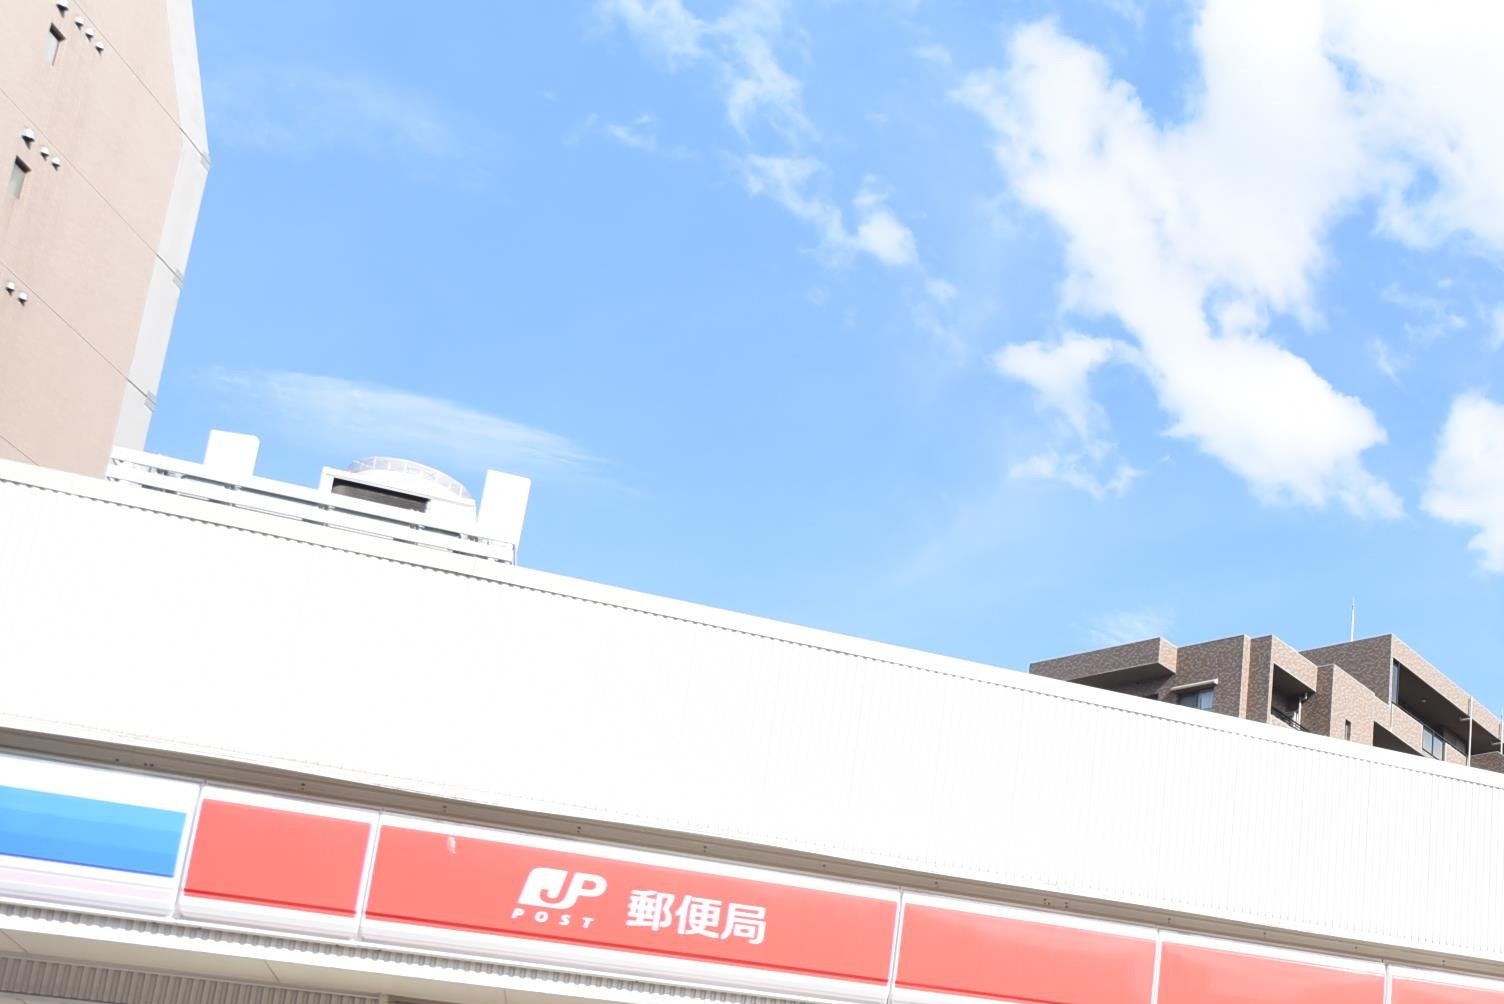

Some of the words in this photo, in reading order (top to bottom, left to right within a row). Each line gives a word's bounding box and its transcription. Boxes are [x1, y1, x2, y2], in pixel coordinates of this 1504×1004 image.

[517, 867, 607, 910] JP
[511, 907, 595, 929] POST
[625, 889, 767, 945] 郵便局
